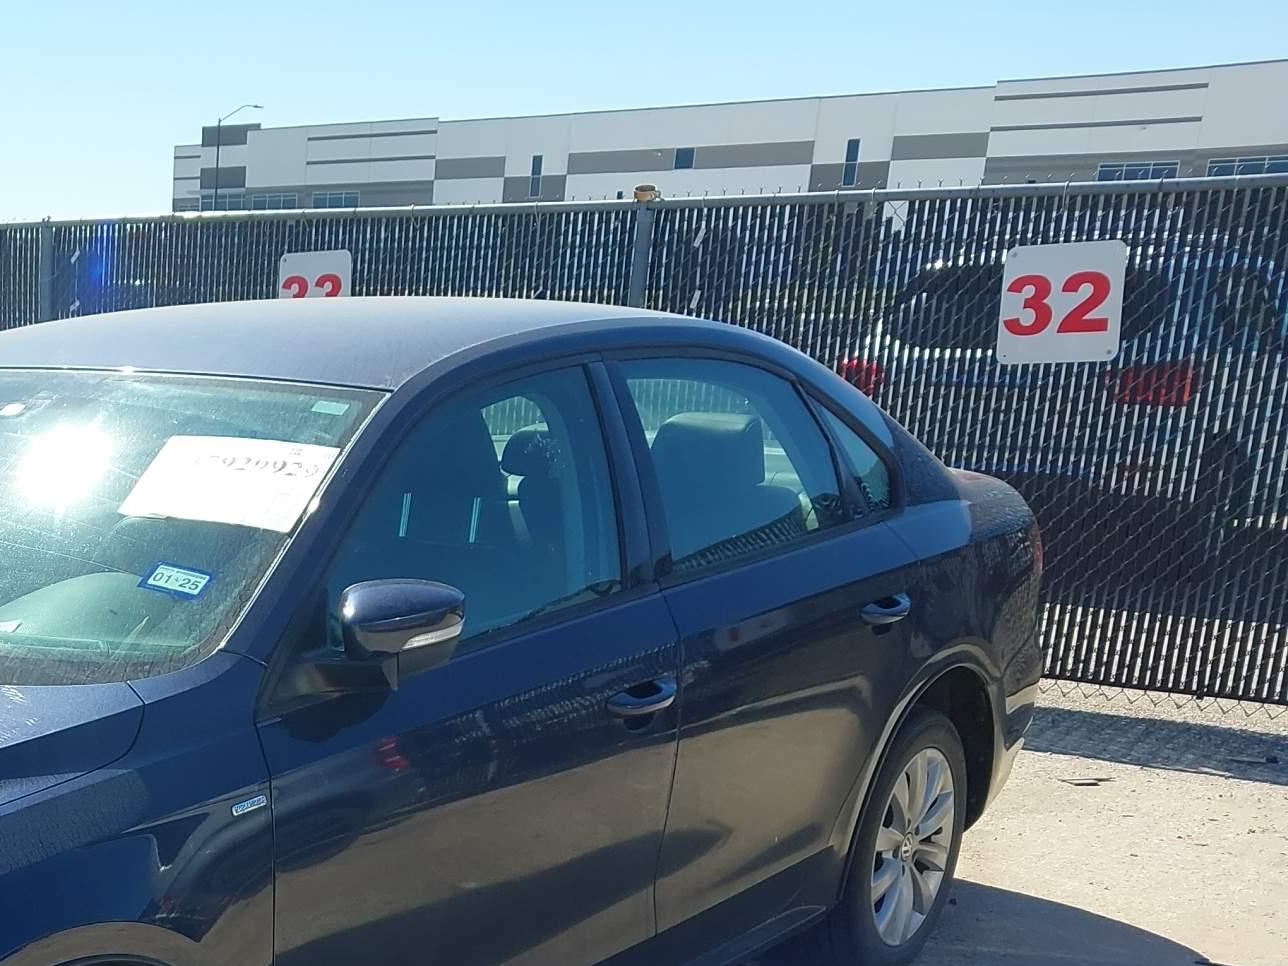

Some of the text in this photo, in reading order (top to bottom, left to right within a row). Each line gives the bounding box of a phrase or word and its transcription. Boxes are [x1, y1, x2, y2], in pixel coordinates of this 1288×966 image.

[1002, 270, 1111, 337] 32
[152, 572, 173, 584] 01
[178, 577, 201, 591] 25
